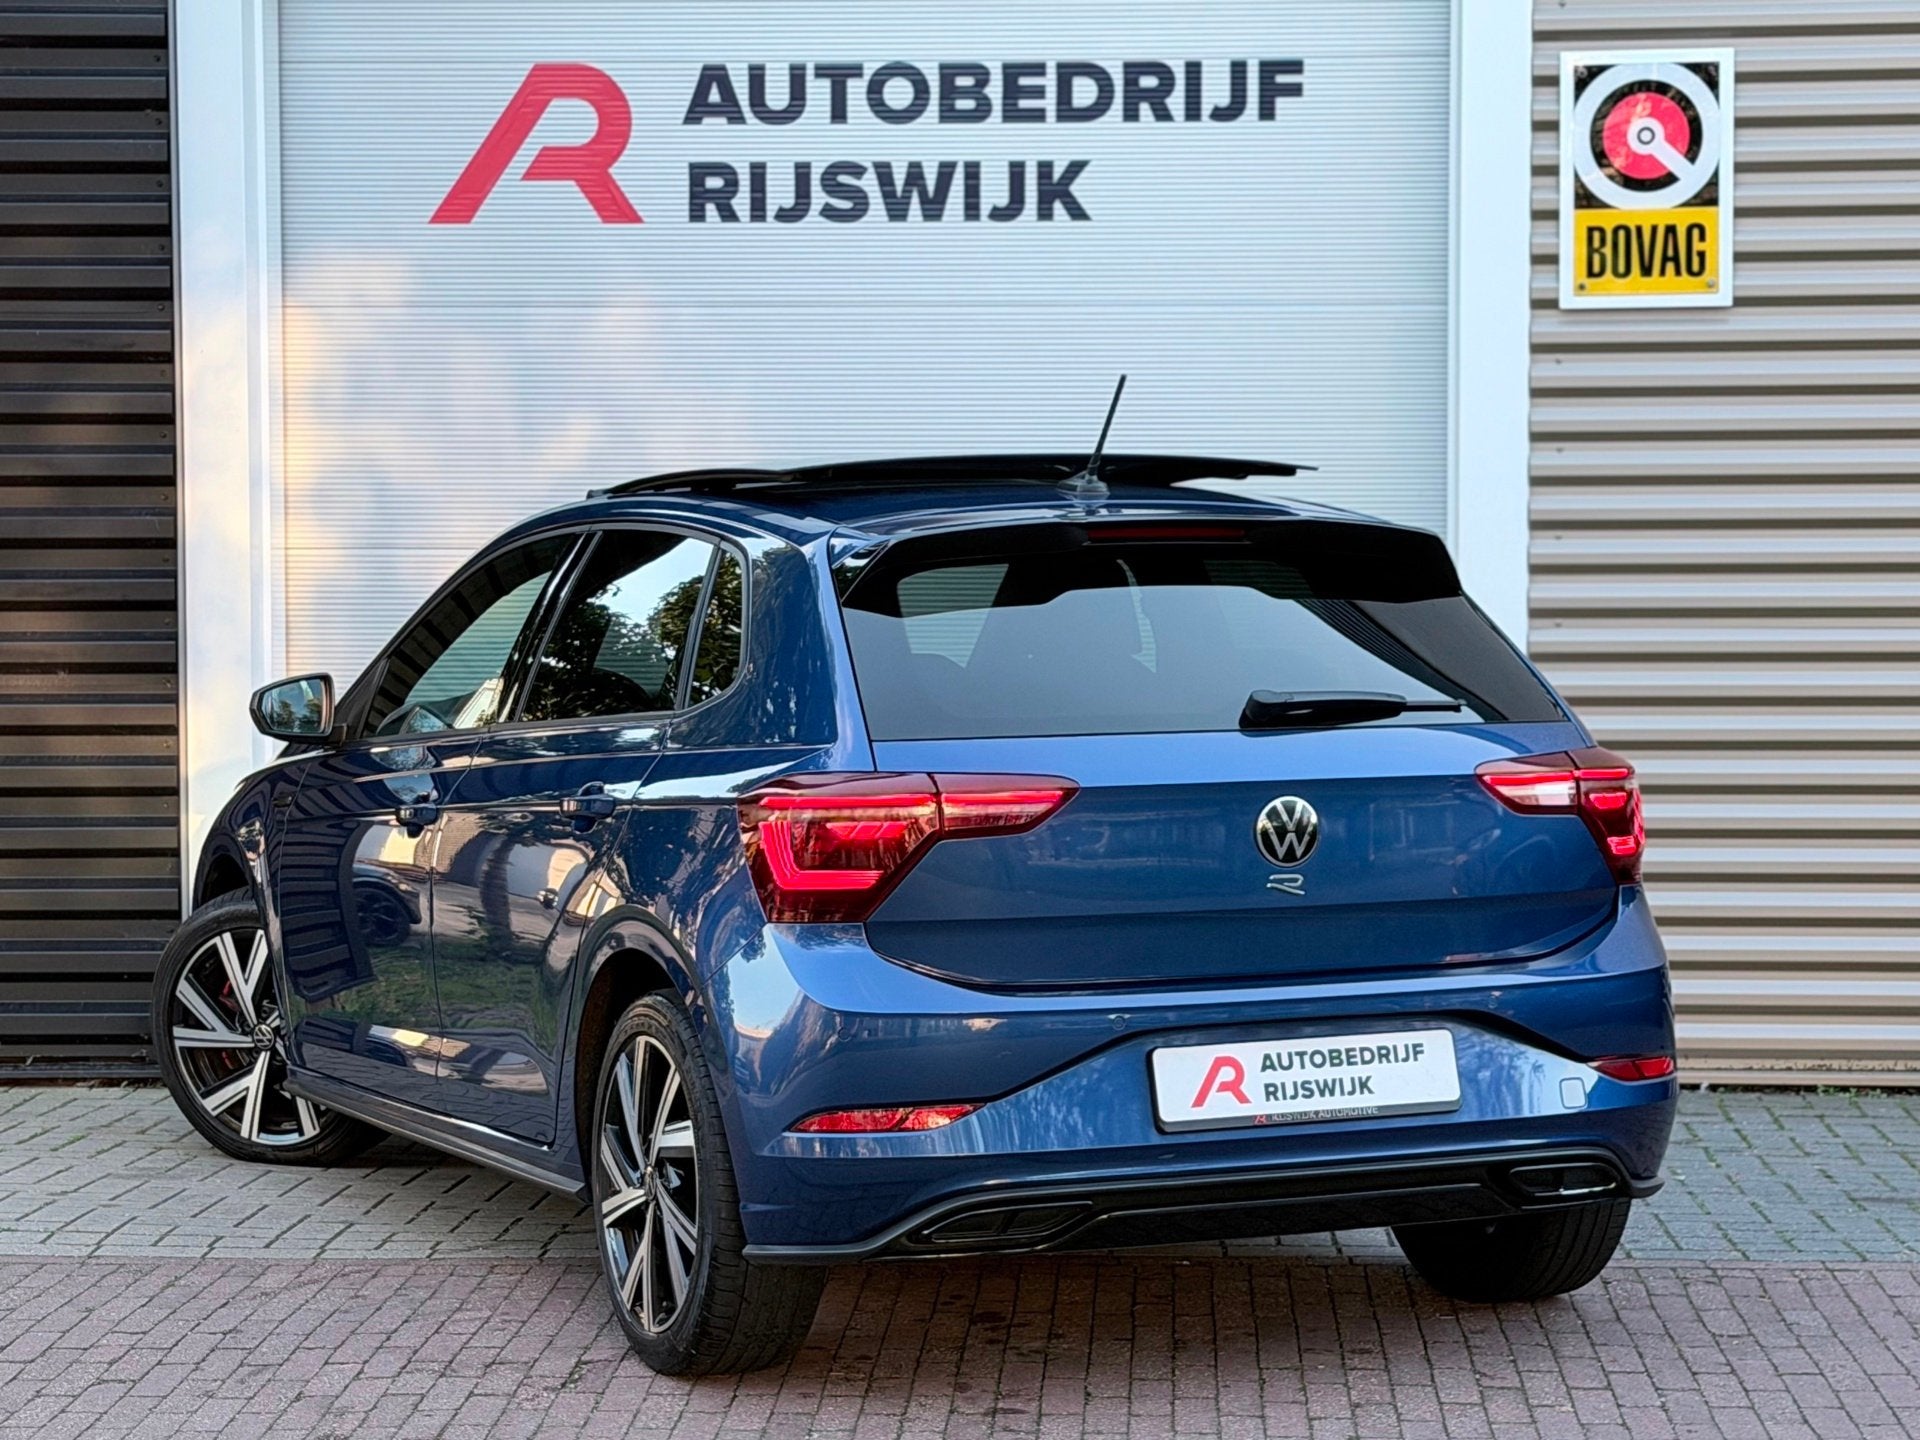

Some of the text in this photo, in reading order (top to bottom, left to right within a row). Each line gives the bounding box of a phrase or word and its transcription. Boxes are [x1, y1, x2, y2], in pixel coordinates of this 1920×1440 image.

[683, 59, 1304, 126] AUTOBEDRIJF
[688, 160, 1091, 224] RIJSWIJK
[1586, 222, 1707, 279] BOVAG
[1260, 1042, 1425, 1073] AUTOBEDRIJF
[1264, 1075, 1375, 1102] RIJSWIJK
